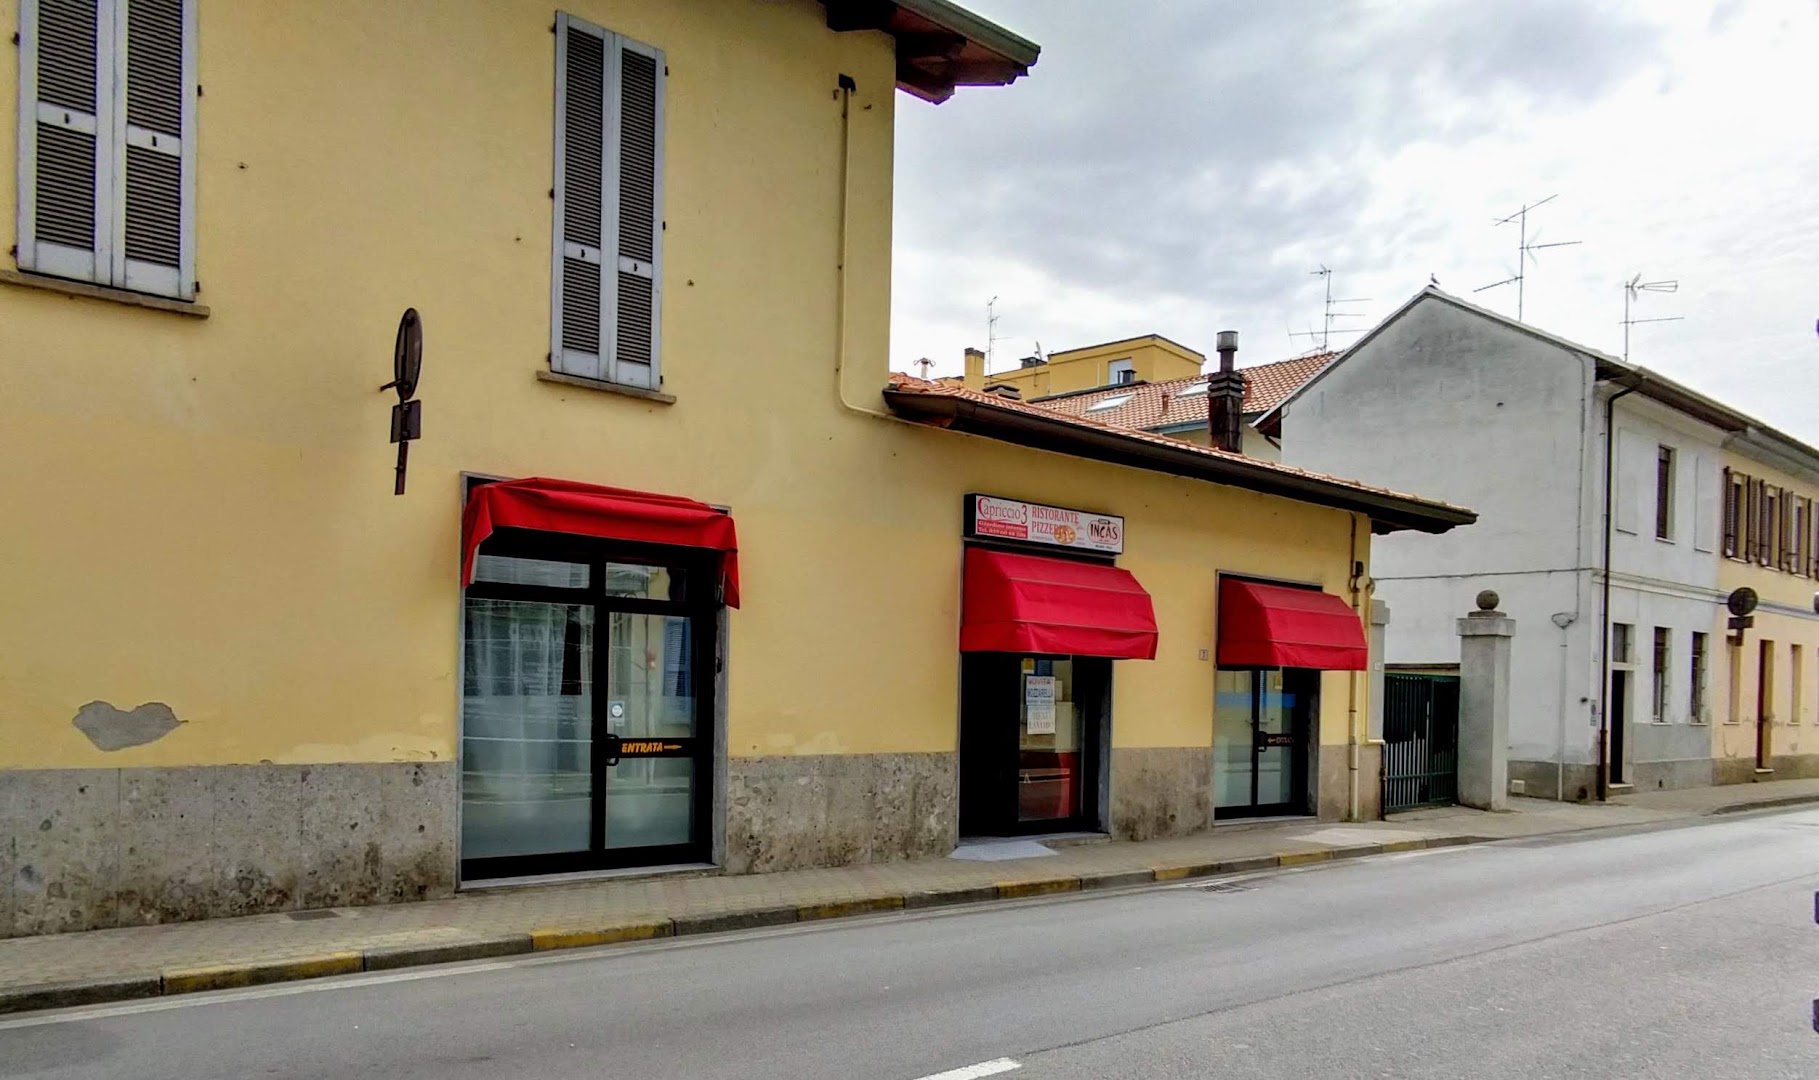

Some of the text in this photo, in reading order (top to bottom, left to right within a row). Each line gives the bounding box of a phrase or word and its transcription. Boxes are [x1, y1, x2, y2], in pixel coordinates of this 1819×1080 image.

[977, 497, 1027, 525] Capriccio 3
[1031, 506, 1079, 524] RISTORANTE
[1090, 523, 1118, 540] INCAS
[621, 742, 663, 753] ENTRATA
